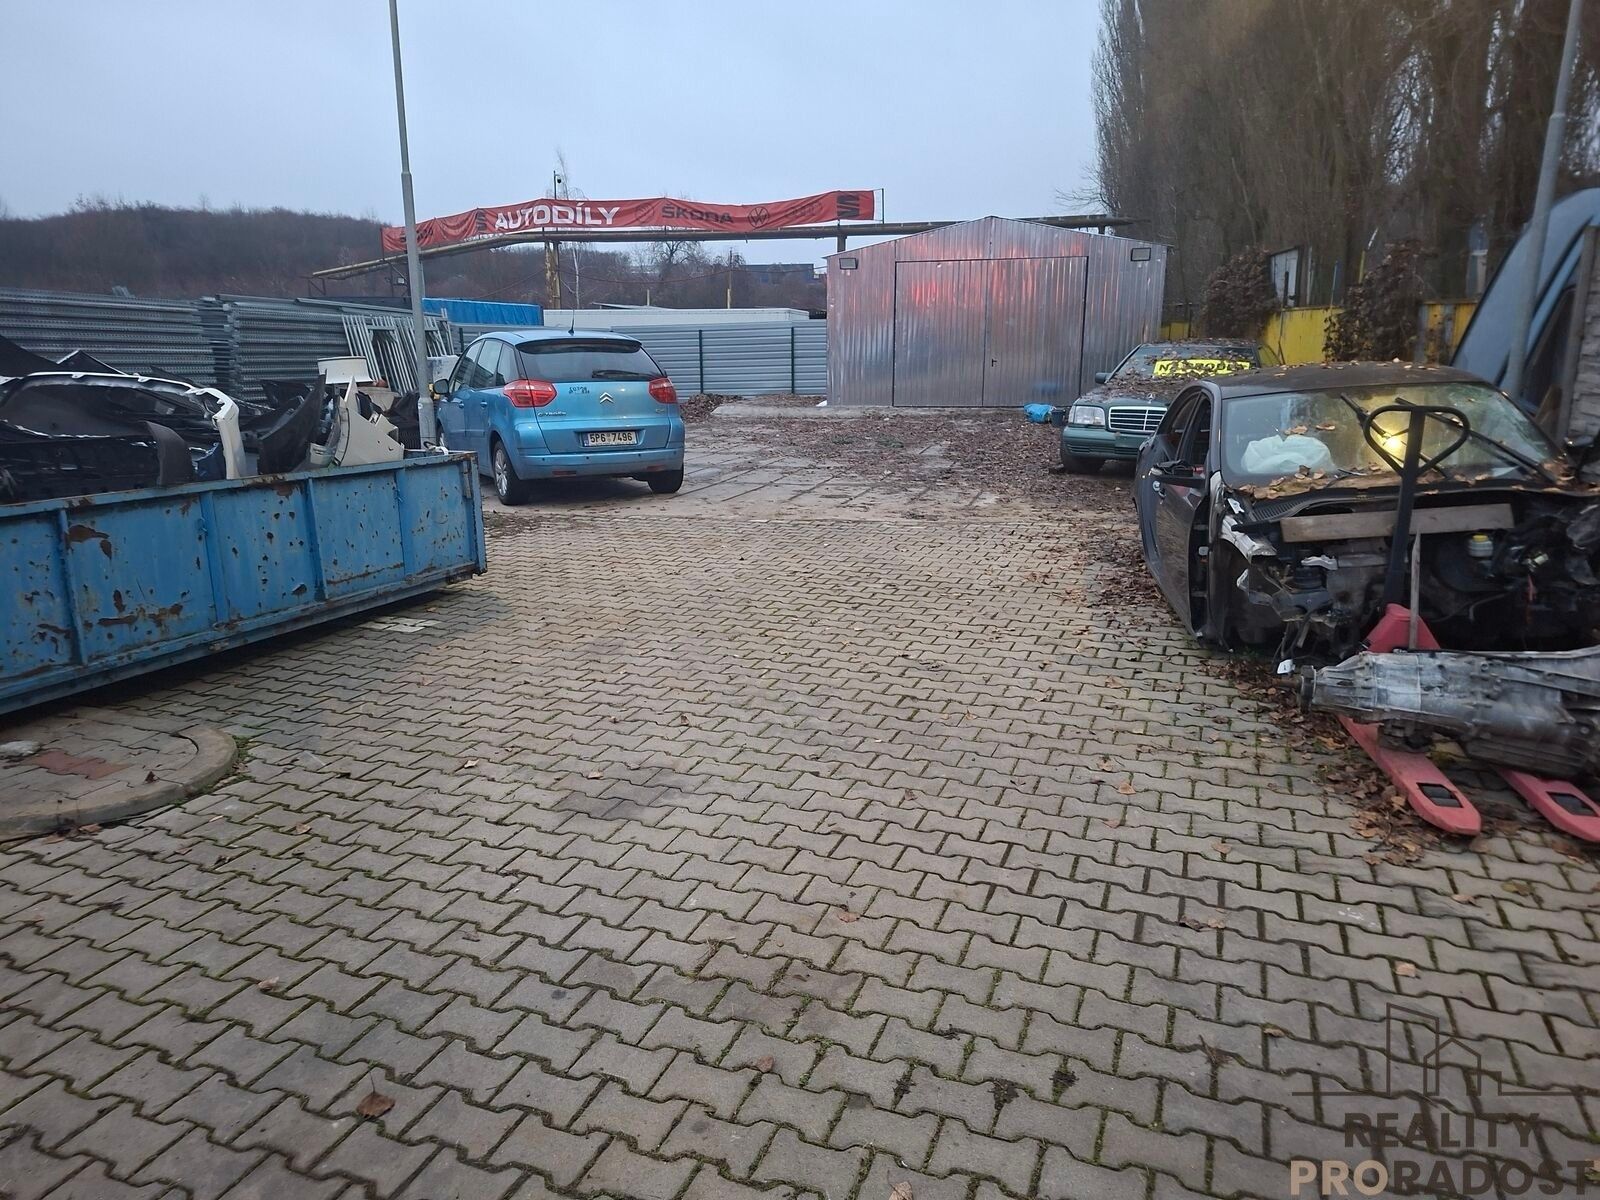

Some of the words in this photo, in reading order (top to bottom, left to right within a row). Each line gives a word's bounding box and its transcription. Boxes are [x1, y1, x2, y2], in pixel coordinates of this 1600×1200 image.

[494, 202, 620, 231] AUTODÍLY
[589, 433, 606, 443] 5P6
[611, 432, 633, 442] 7496
